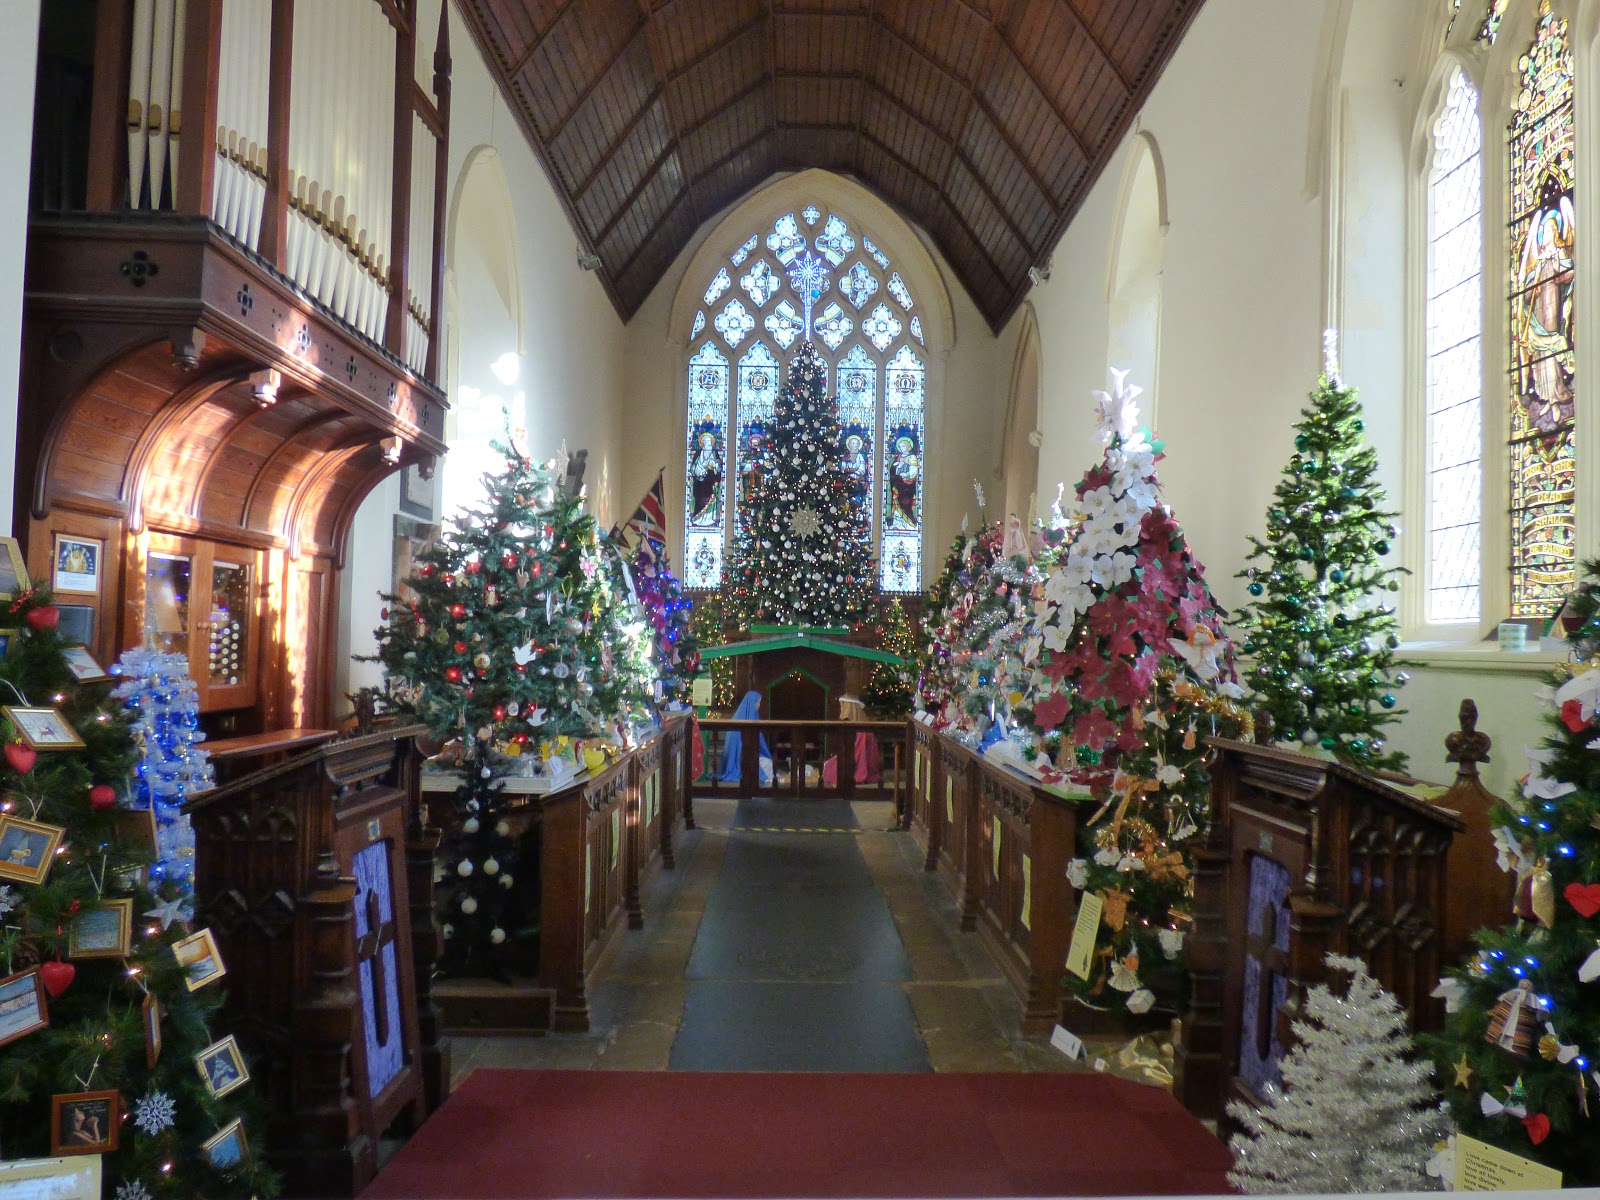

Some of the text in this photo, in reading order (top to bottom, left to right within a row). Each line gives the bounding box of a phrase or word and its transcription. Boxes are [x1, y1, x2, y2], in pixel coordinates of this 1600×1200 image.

[1537, 490, 1562, 502] DEAD
[1535, 515, 1563, 528] SHALL
[1542, 544, 1570, 556] RAISED
[1465, 1151, 1480, 1161] Love
[1482, 1158, 1498, 1167] came
[1499, 1165, 1516, 1175] down
